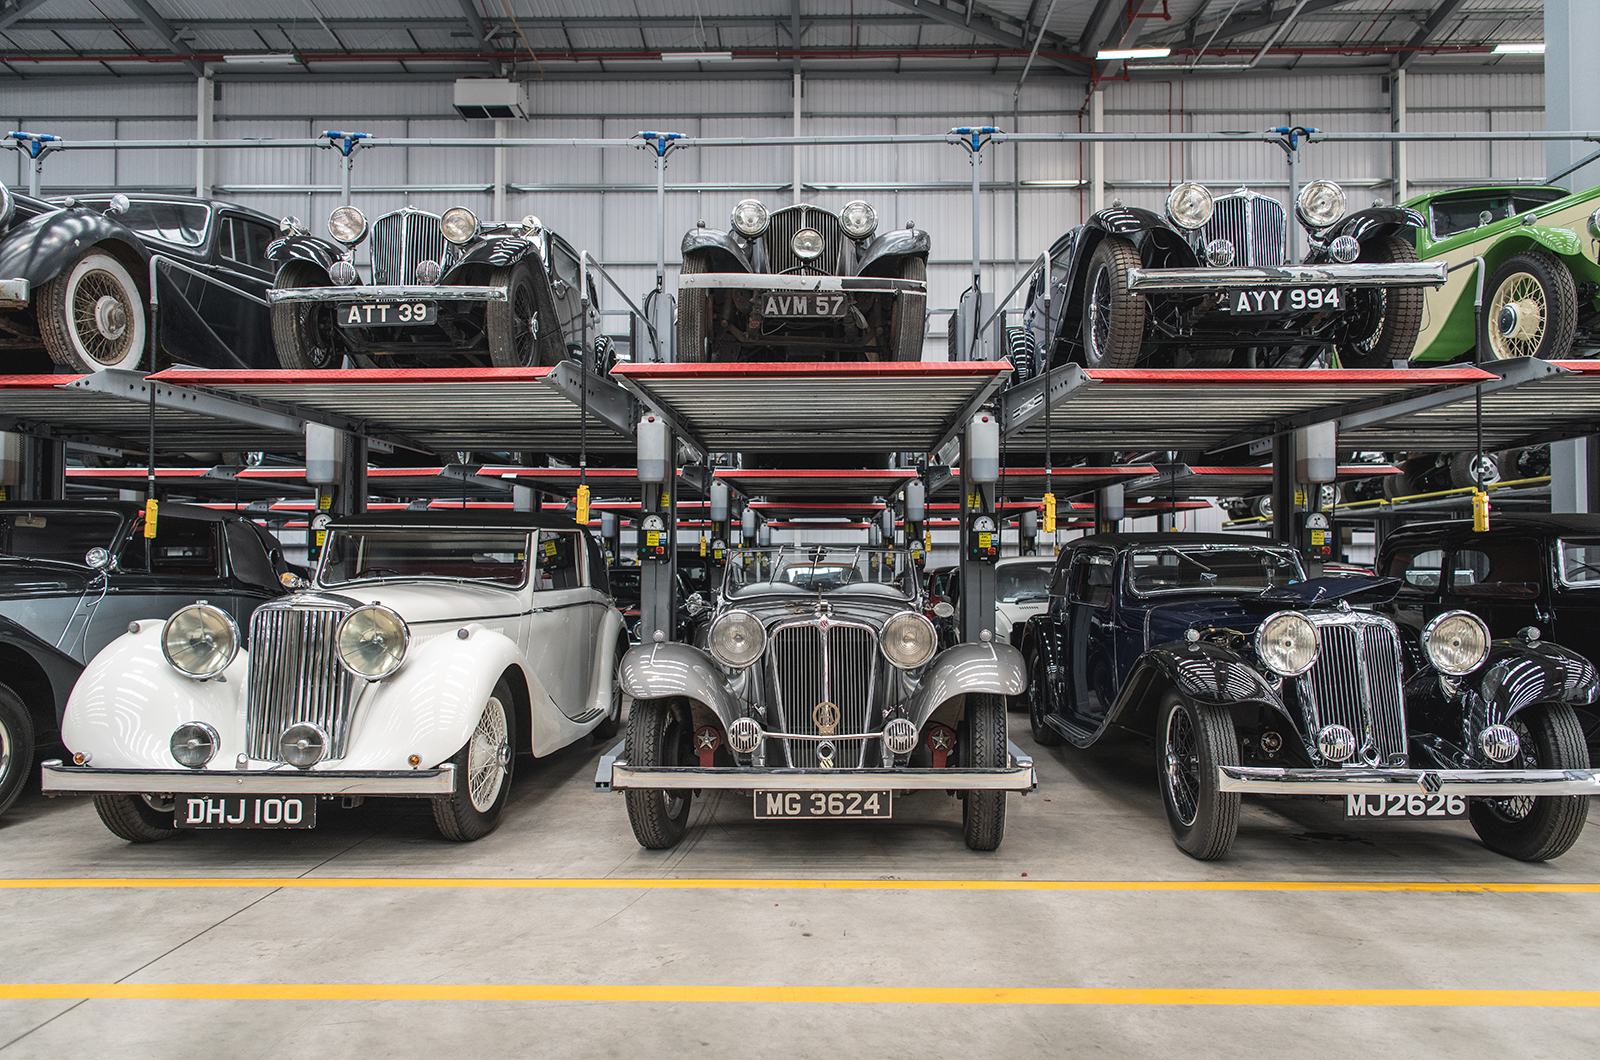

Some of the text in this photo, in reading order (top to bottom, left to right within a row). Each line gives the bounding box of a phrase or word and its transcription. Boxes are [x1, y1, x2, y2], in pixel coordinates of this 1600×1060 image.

[764, 296, 844, 315] AVM 57
[1236, 287, 1340, 312] AYY 994
[347, 303, 427, 323] ATT 39
[186, 798, 303, 824] DHJ 100
[766, 792, 880, 815] MG 3624
[1347, 794, 1466, 816] MJ2626
